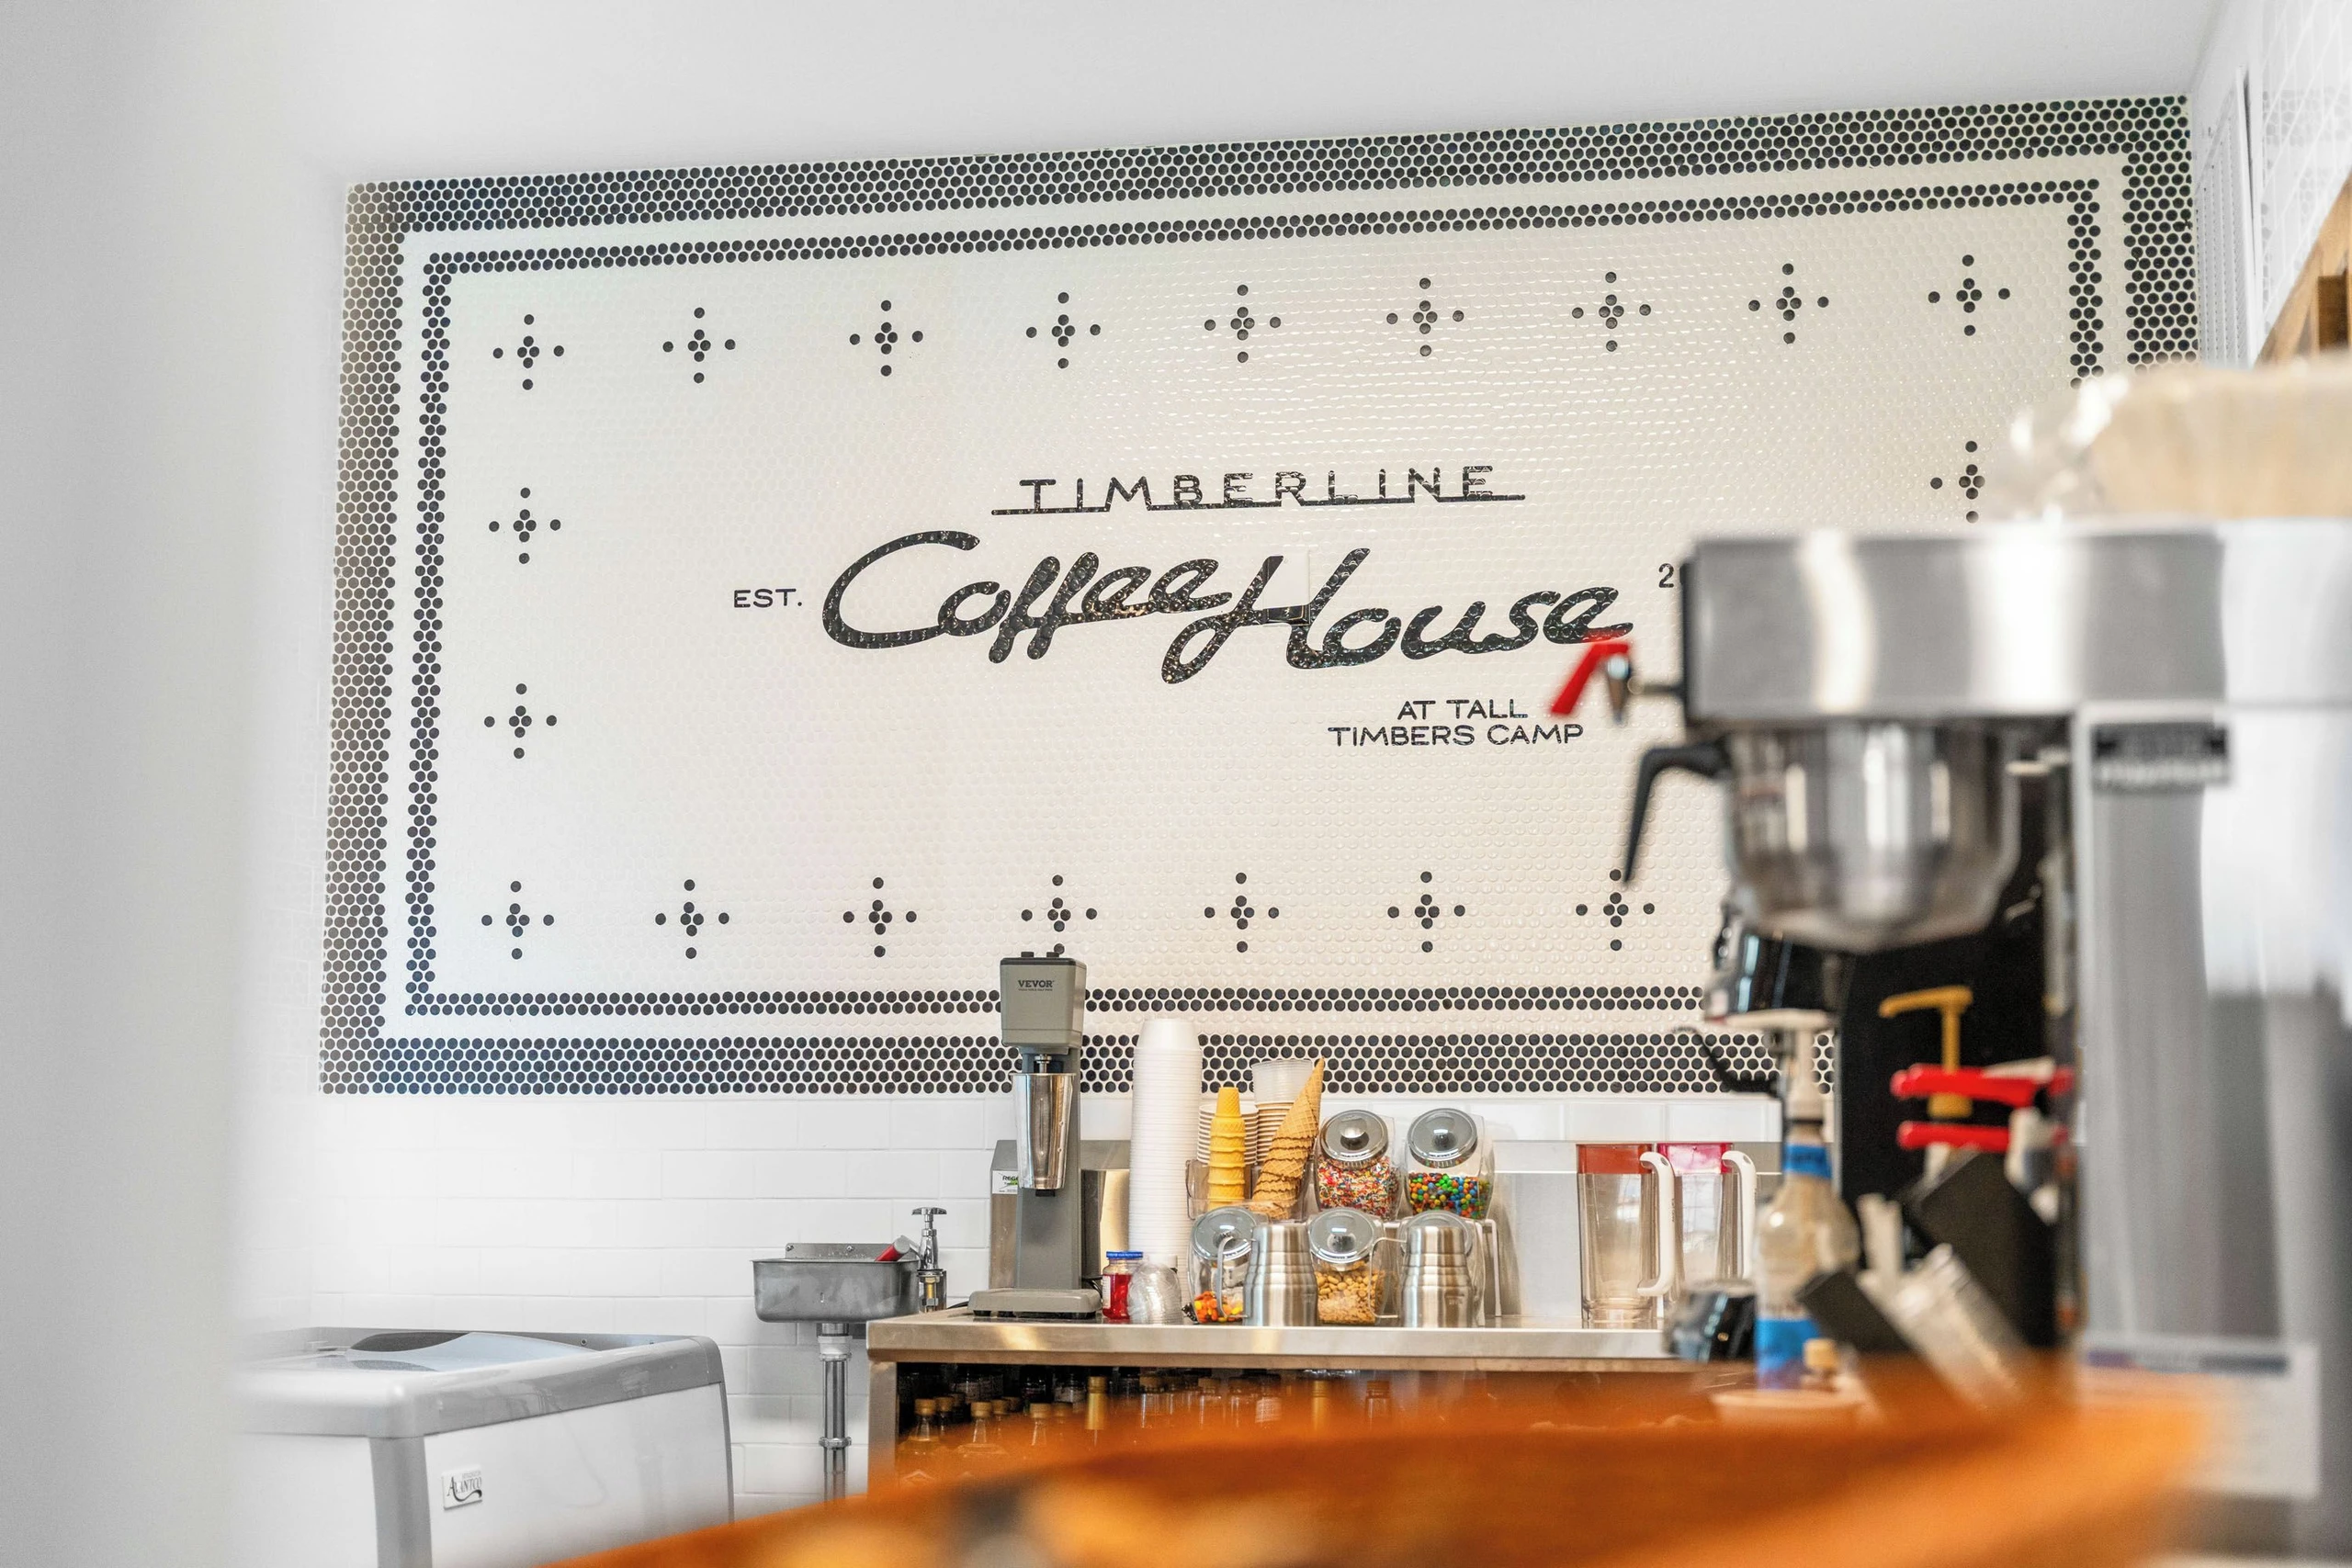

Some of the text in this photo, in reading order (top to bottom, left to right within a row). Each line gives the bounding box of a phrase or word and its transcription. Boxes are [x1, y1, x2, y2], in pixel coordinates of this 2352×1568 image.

[1014, 464, 1498, 514] TIMBERLINE
[732, 587, 805, 610] EST.
[821, 529, 1634, 684] Coffee House
[1396, 697, 1529, 721] AT TALL
[1327, 722, 1585, 748] TIMBERS CAMP
[1017, 978, 1054, 988] VEVOR
